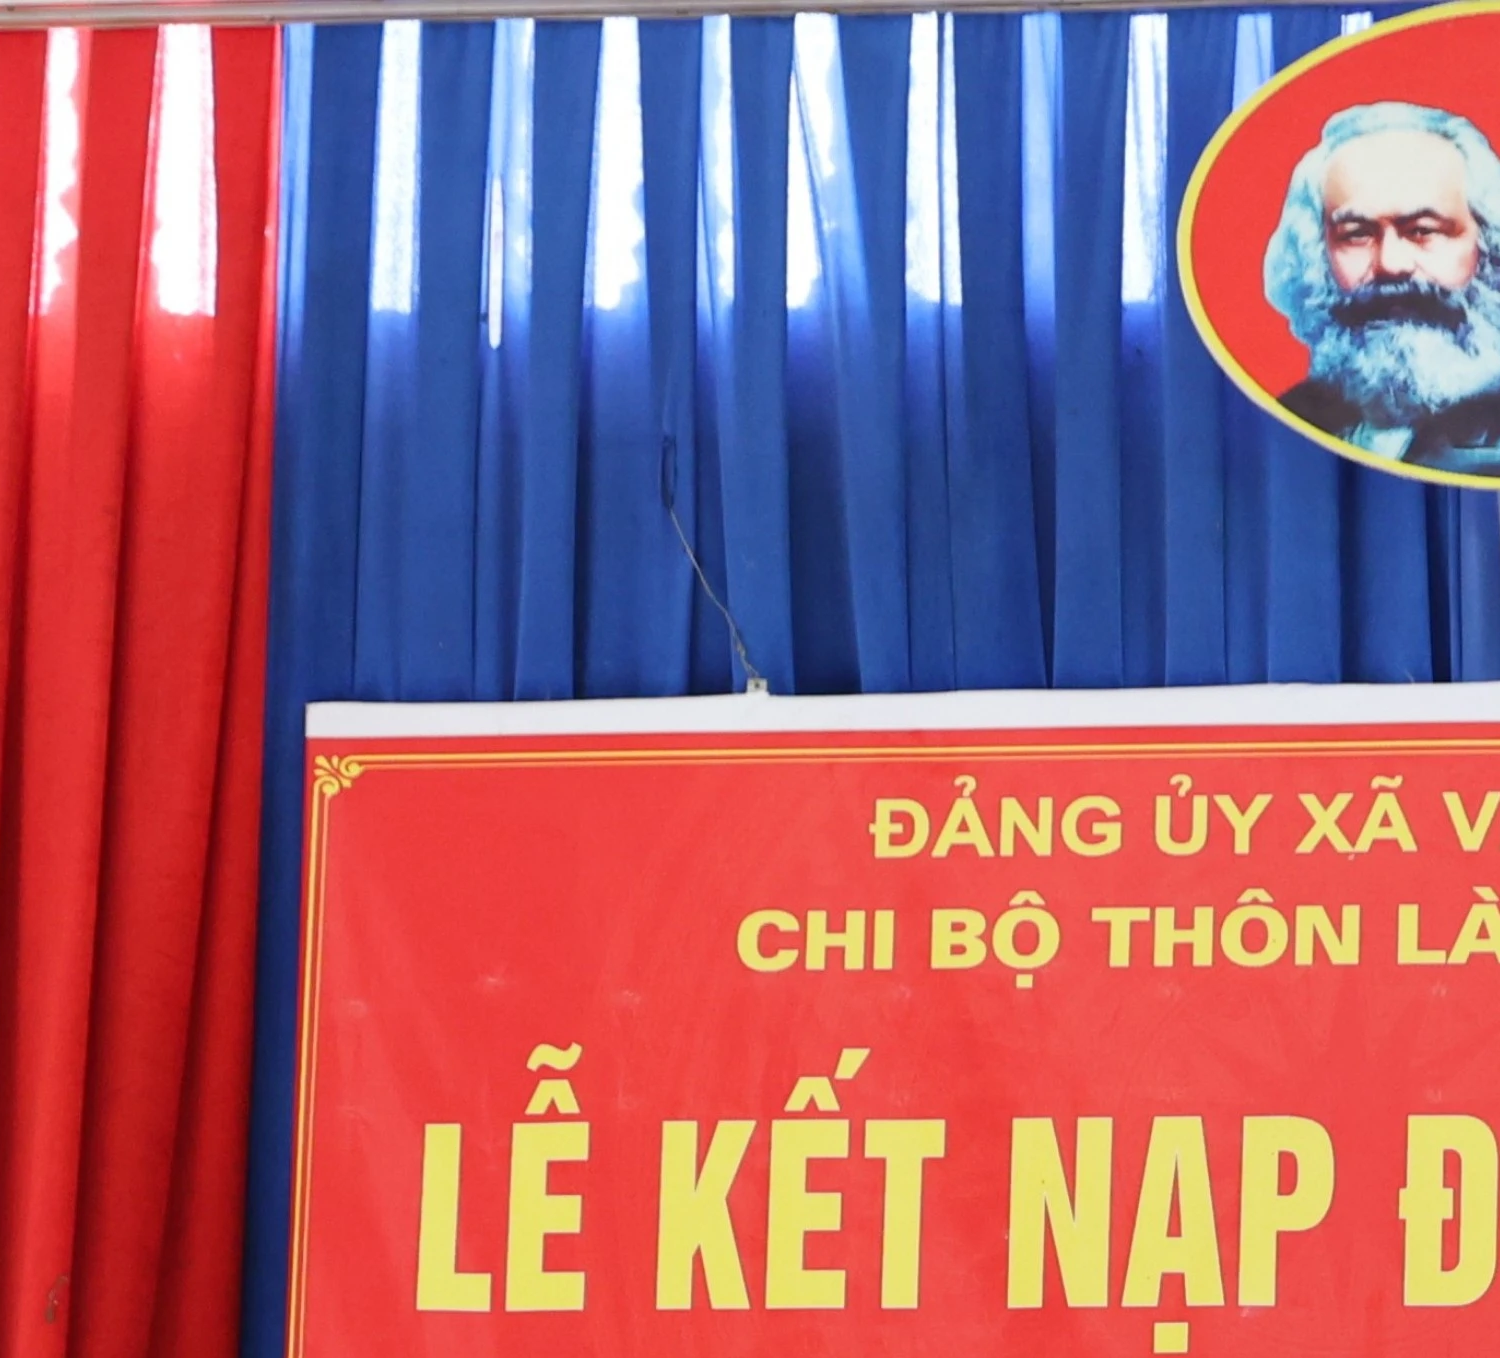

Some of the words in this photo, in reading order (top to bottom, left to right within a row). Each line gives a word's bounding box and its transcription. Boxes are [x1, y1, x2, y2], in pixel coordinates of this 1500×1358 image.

[868, 774, 1123, 860] ĐẢNG
[1154, 773, 1274, 858] ỦY
[1294, 774, 1419, 860] XÃ
[736, 909, 896, 973] CHI
[930, 889, 1061, 990] BỘ
[1090, 887, 1361, 969] THÔN
[415, 1042, 591, 1313] LỄ
[655, 1047, 947, 1311] KẾT
[1006, 1114, 1336, 1355] NẠP
